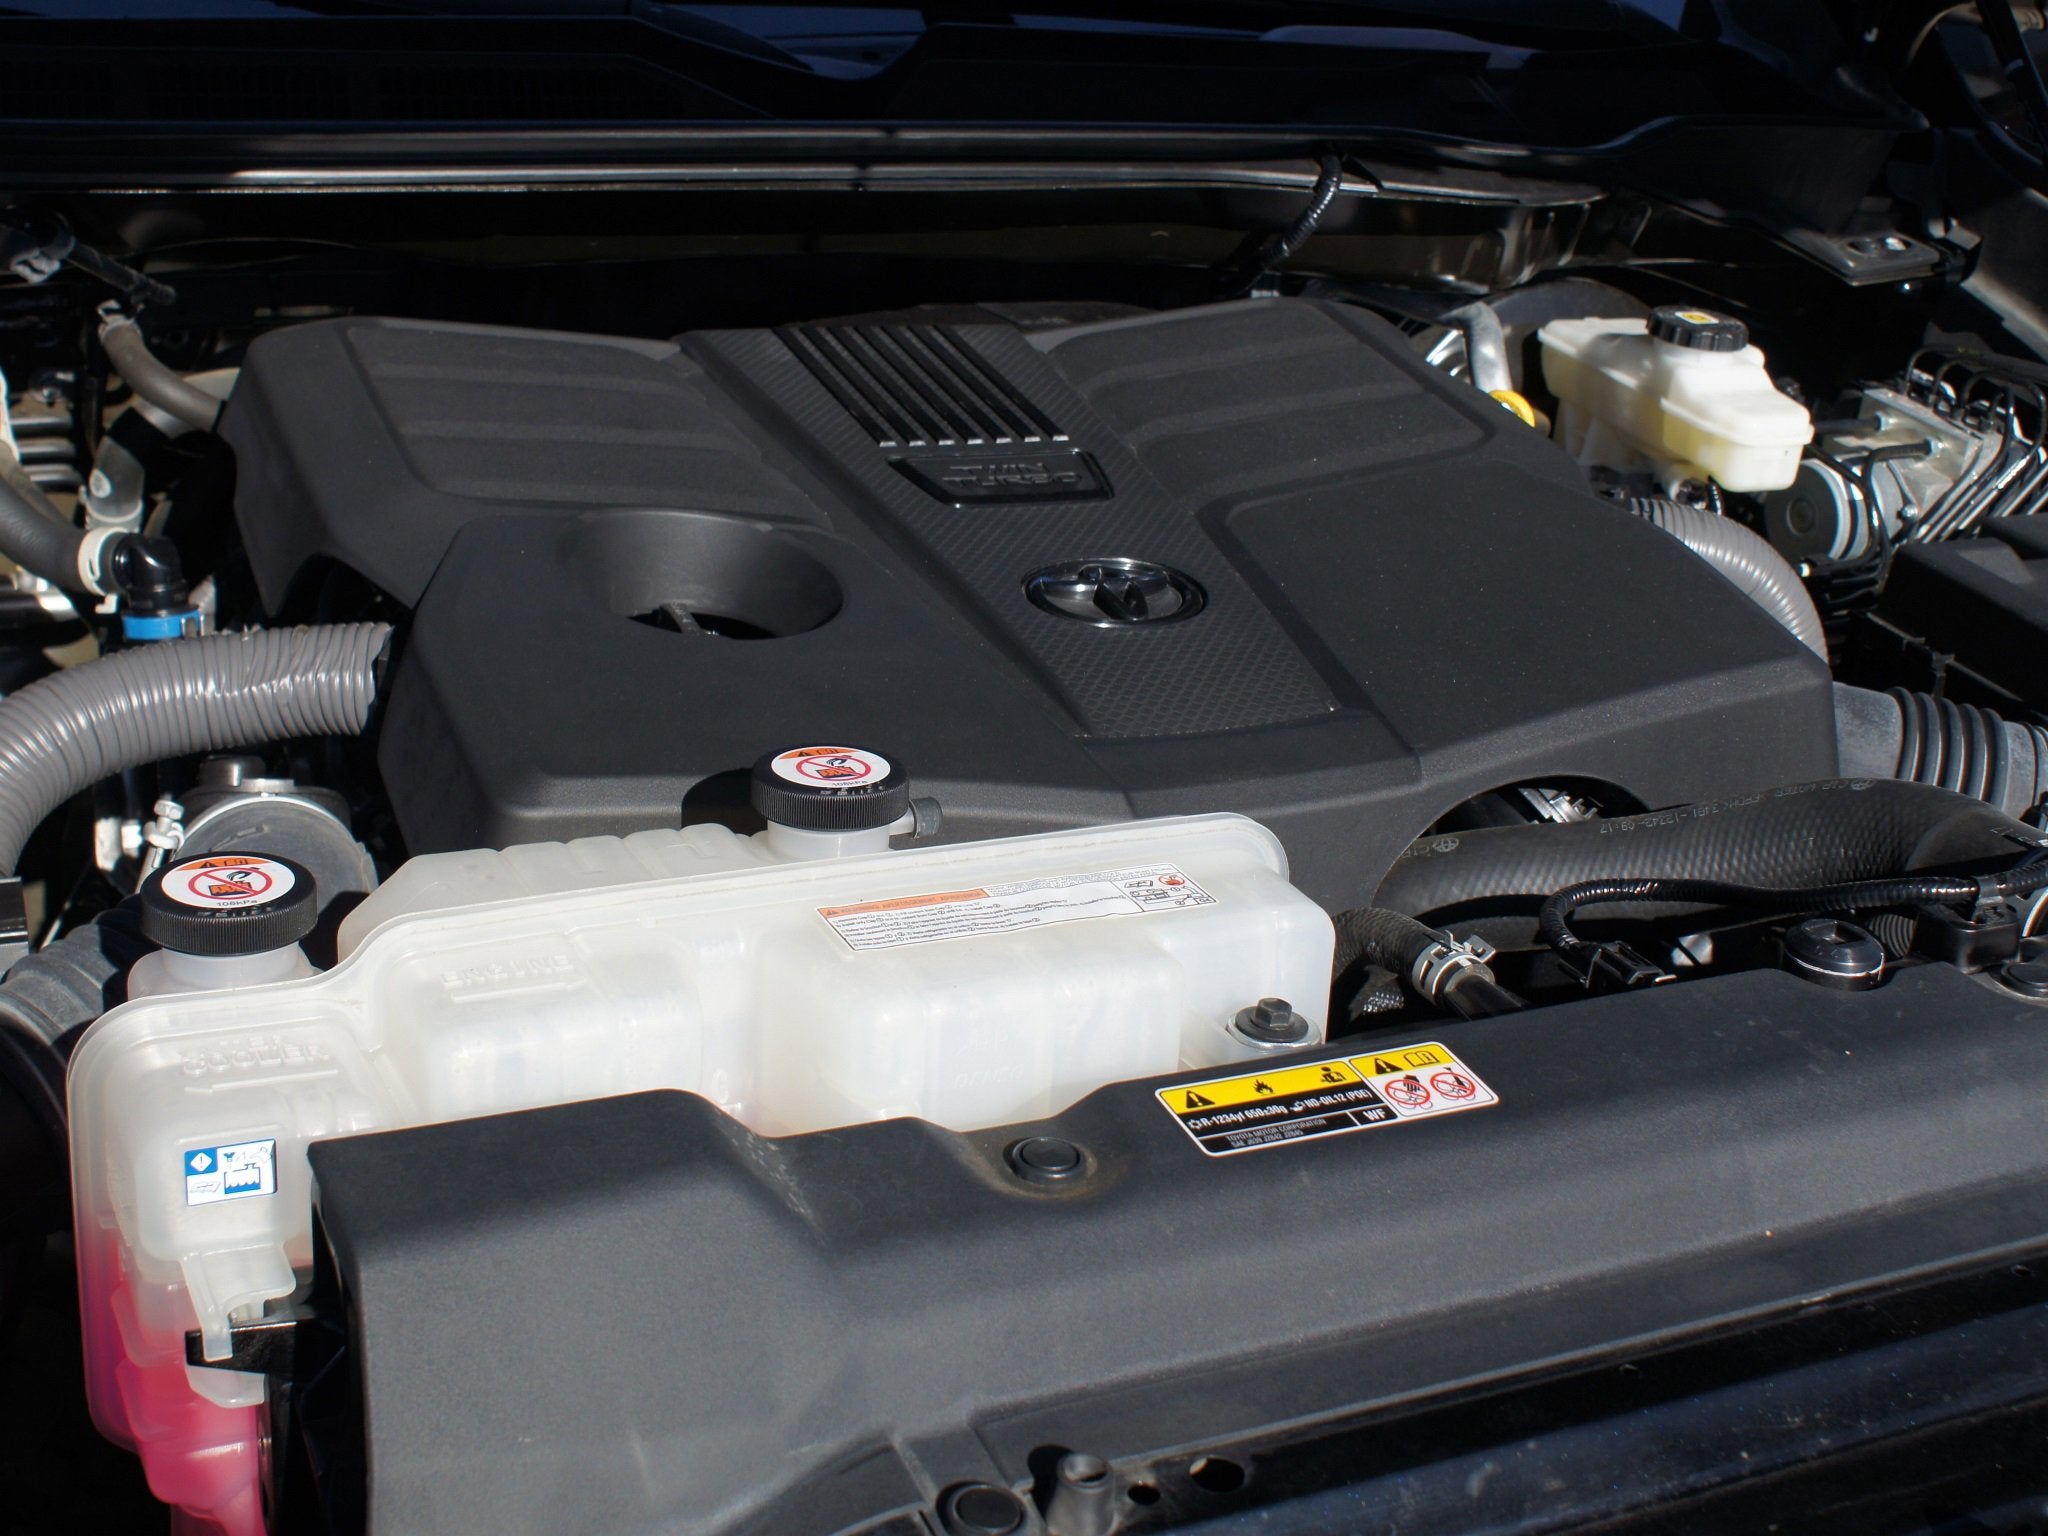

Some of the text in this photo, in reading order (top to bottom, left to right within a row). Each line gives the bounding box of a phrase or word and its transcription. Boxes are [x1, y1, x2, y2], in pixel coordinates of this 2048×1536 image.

[949, 463, 1045, 475] TWIN
[942, 472, 1081, 486] TURBO
[1346, 1088, 1373, 1101] (POE)
[1363, 1108, 1386, 1121] WF
[1225, 1118, 1327, 1143] TOYOTA MOTOR CORPORATION
